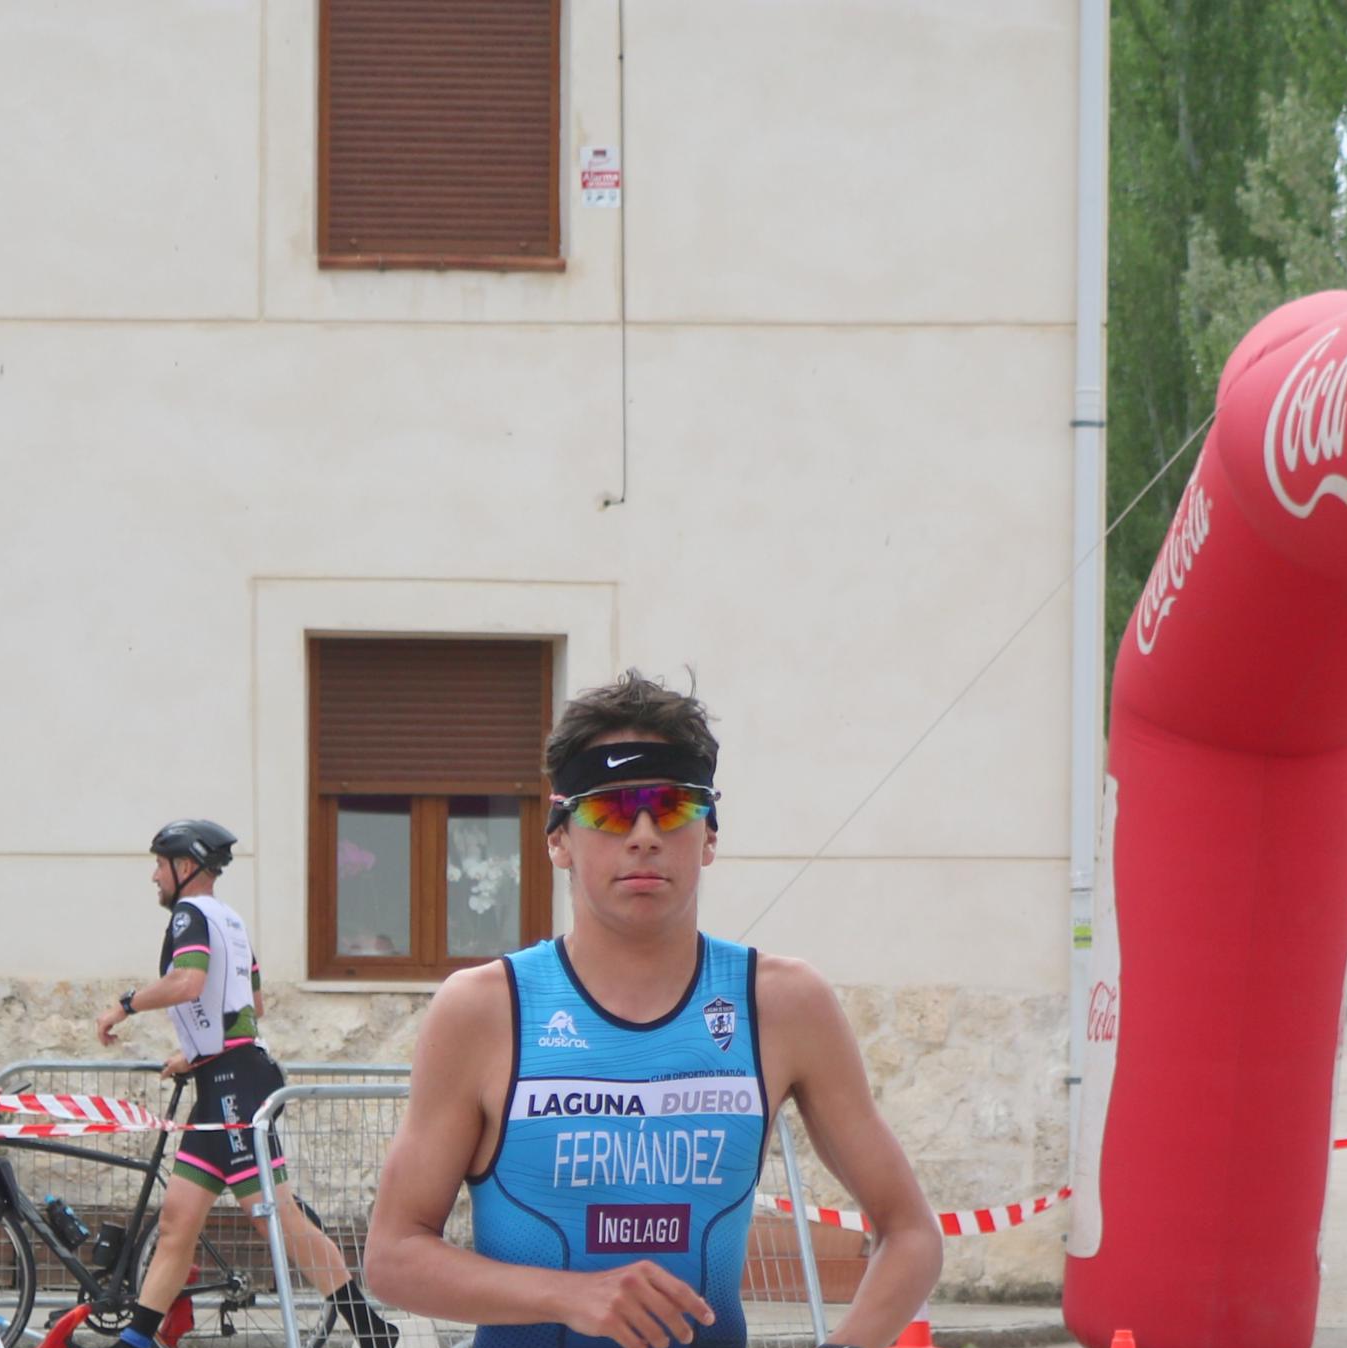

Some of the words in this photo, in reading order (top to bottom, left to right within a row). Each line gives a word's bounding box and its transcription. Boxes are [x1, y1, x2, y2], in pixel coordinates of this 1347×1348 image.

[538, 1034, 590, 1049] austral
[527, 1092, 646, 1117] LAGUNA
[553, 1119, 726, 1188] FERNÁNDEZ
[598, 1211, 680, 1244] INGLAGO
